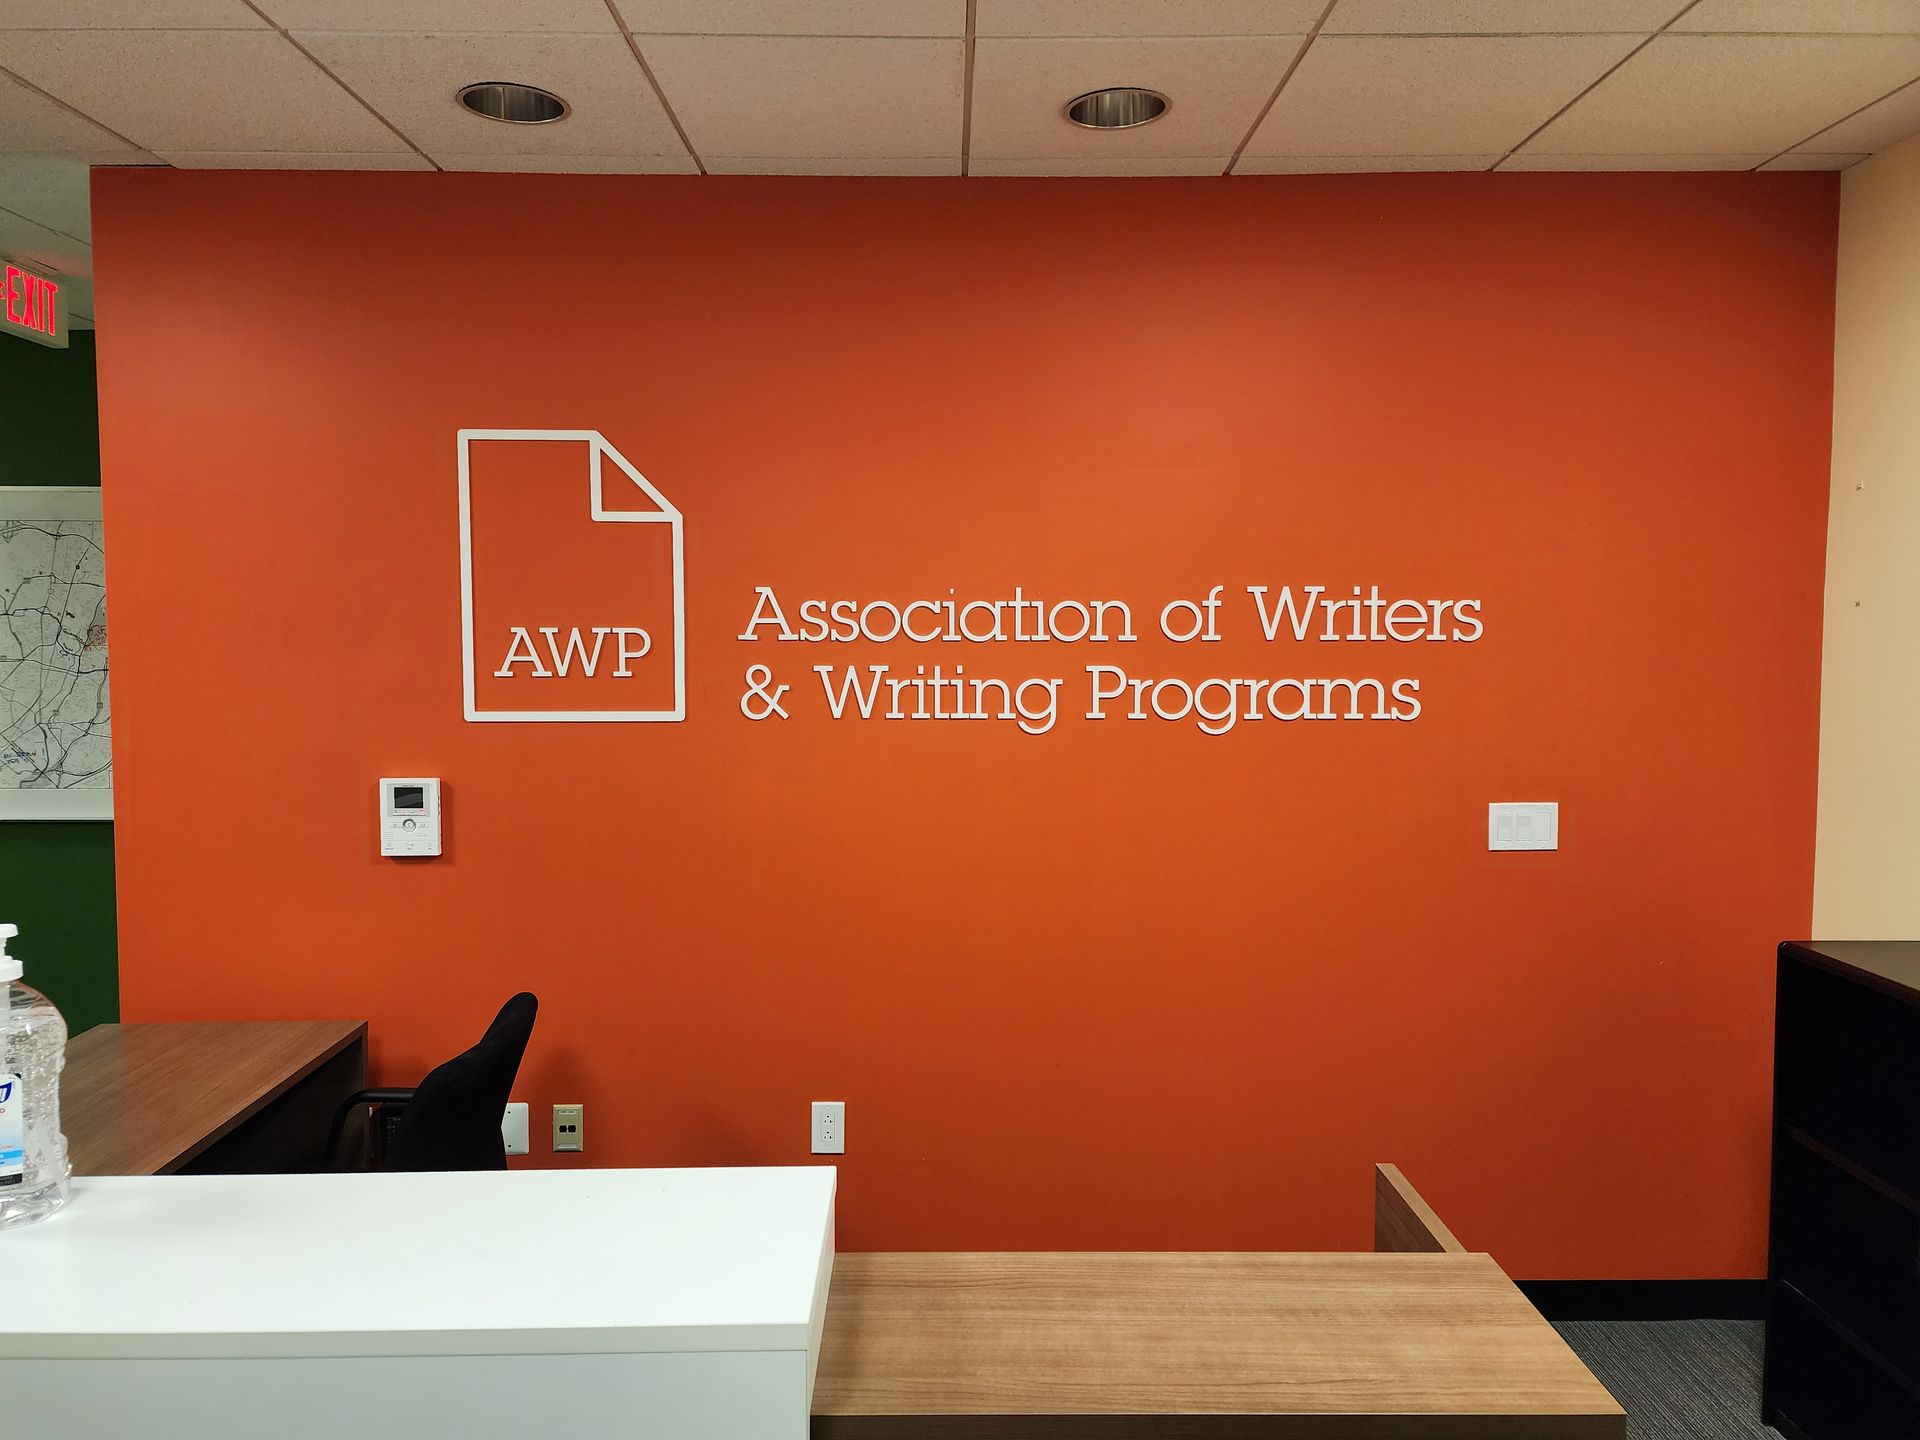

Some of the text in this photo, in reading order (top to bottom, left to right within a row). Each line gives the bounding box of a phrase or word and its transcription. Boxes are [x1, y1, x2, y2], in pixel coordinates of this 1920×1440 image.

[6, 265, 58, 337] EXIT
[737, 584, 1484, 643] Association of Writers
[493, 626, 652, 677] AWP
[740, 663, 1422, 735] & Writing Programs
